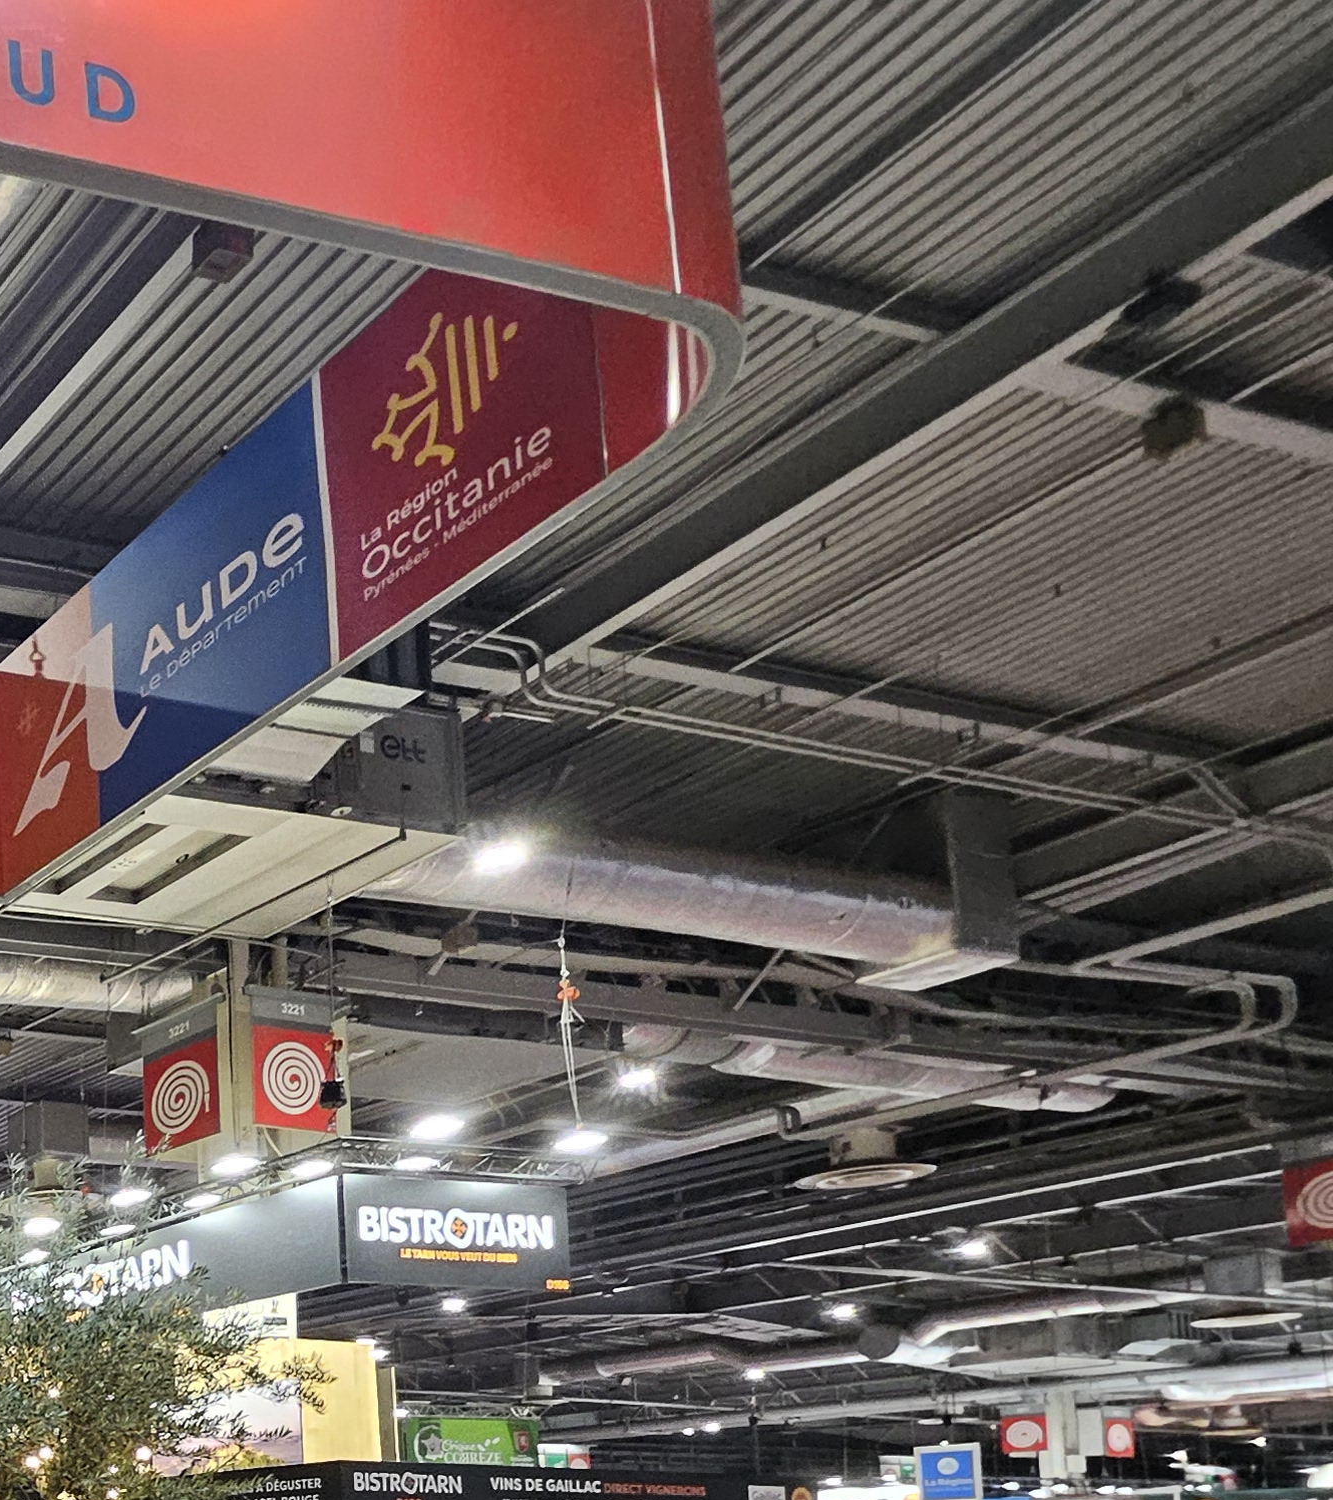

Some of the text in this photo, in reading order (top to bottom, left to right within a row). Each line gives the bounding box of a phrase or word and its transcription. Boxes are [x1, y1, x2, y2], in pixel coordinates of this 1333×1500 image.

[360, 466, 459, 551] La Région
[361, 425, 552, 579] Occitanie
[363, 456, 554, 602] Pyrénées Méditerranée
[281, 1002, 306, 1017] 3221
[168, 1020, 191, 1039] 3221
[357, 1205, 555, 1250] BISTROTARN
[265, 1477, 322, 1494] DÉGUSTER
[353, 1471, 463, 1495] BISTROTARN
[490, 1476, 522, 1491] VINS
[524, 1478, 544, 1492] DE
[545, 1479, 602, 1495] GAILLAC
